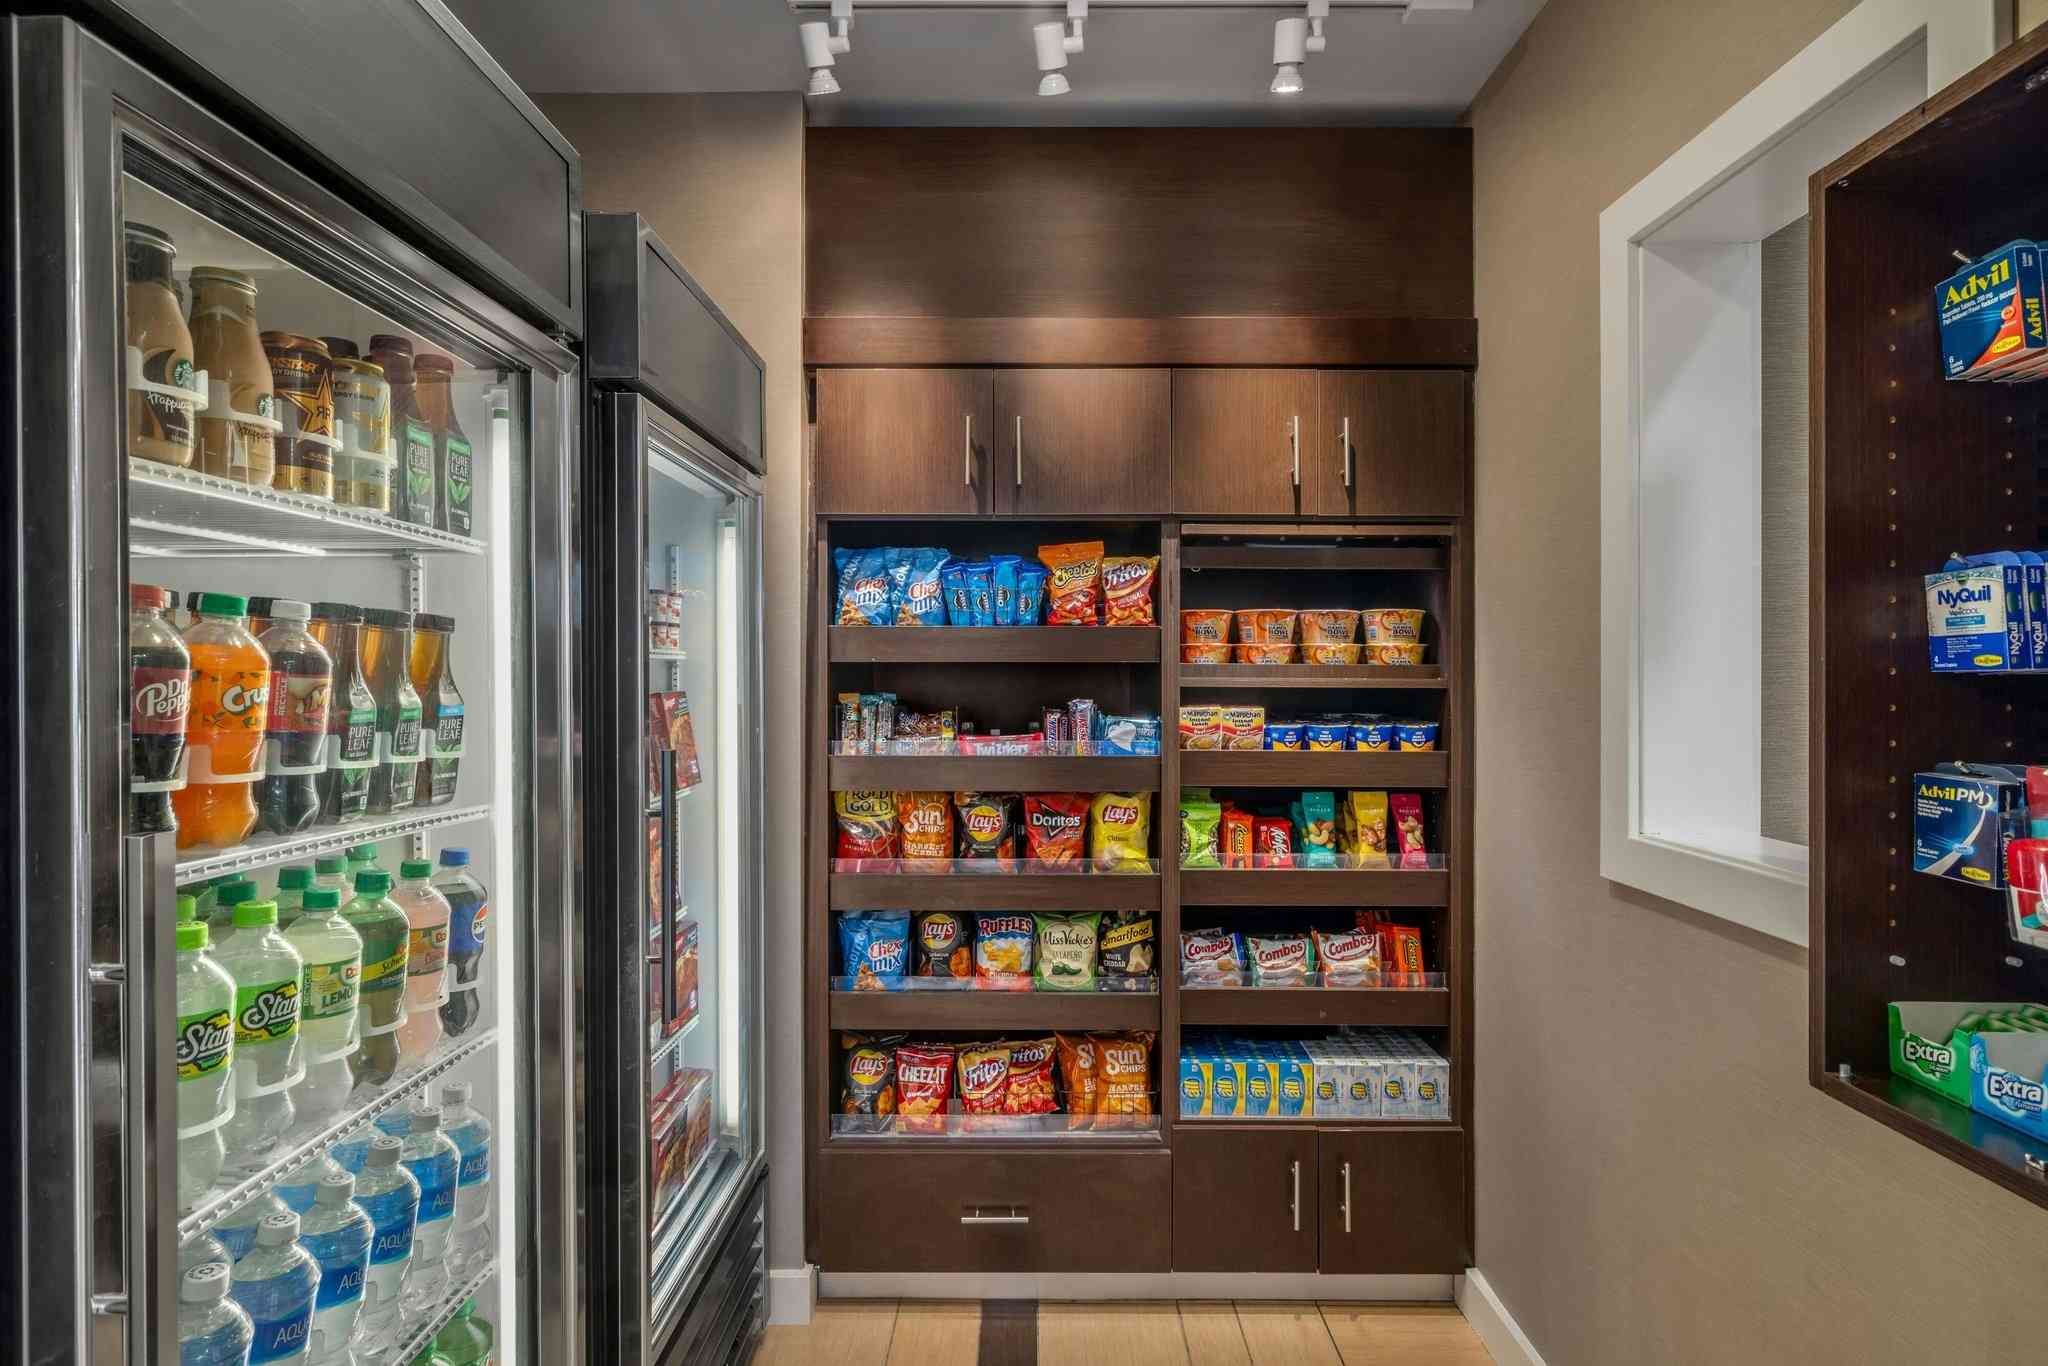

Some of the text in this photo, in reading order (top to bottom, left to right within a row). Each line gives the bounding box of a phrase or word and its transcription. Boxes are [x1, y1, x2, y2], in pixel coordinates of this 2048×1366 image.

[1943, 259, 2010, 309] Advil
[451, 454, 470, 467] PURE
[451, 464, 470, 477] LEAF
[1053, 560, 1098, 588] Cheetos
[1937, 585, 1992, 609] NyQuil
[350, 727, 374, 738] PURE
[400, 721, 419, 733] PURE
[440, 719, 462, 730] PURE
[348, 739, 371, 751] LEAF
[400, 734, 417, 745] LEAF
[438, 729, 461, 741] LEAF
[1918, 783, 1985, 805] Advil PM
[849, 800, 889, 813] GOLD
[1103, 805, 1138, 823] Lay's
[904, 808, 945, 834] Sun
[919, 824, 945, 833] CHIPS
[968, 815, 1001, 833] Lay's
[1032, 812, 1081, 827] Doritos
[979, 916, 1032, 937] RUFFLES
[1102, 924, 1150, 947] Smartfood
[868, 938, 904, 959] Chex
[1187, 937, 1229, 958] Combos
[1259, 941, 1303, 961] Combos
[1328, 934, 1373, 956] Combos
[1105, 1048, 1147, 1076] Sun
[1905, 1041, 1951, 1065] Extra
[851, 1056, 885, 1076] Lay's
[1121, 1063, 1147, 1073] CHIPS
[1990, 1073, 2042, 1102] Extra
